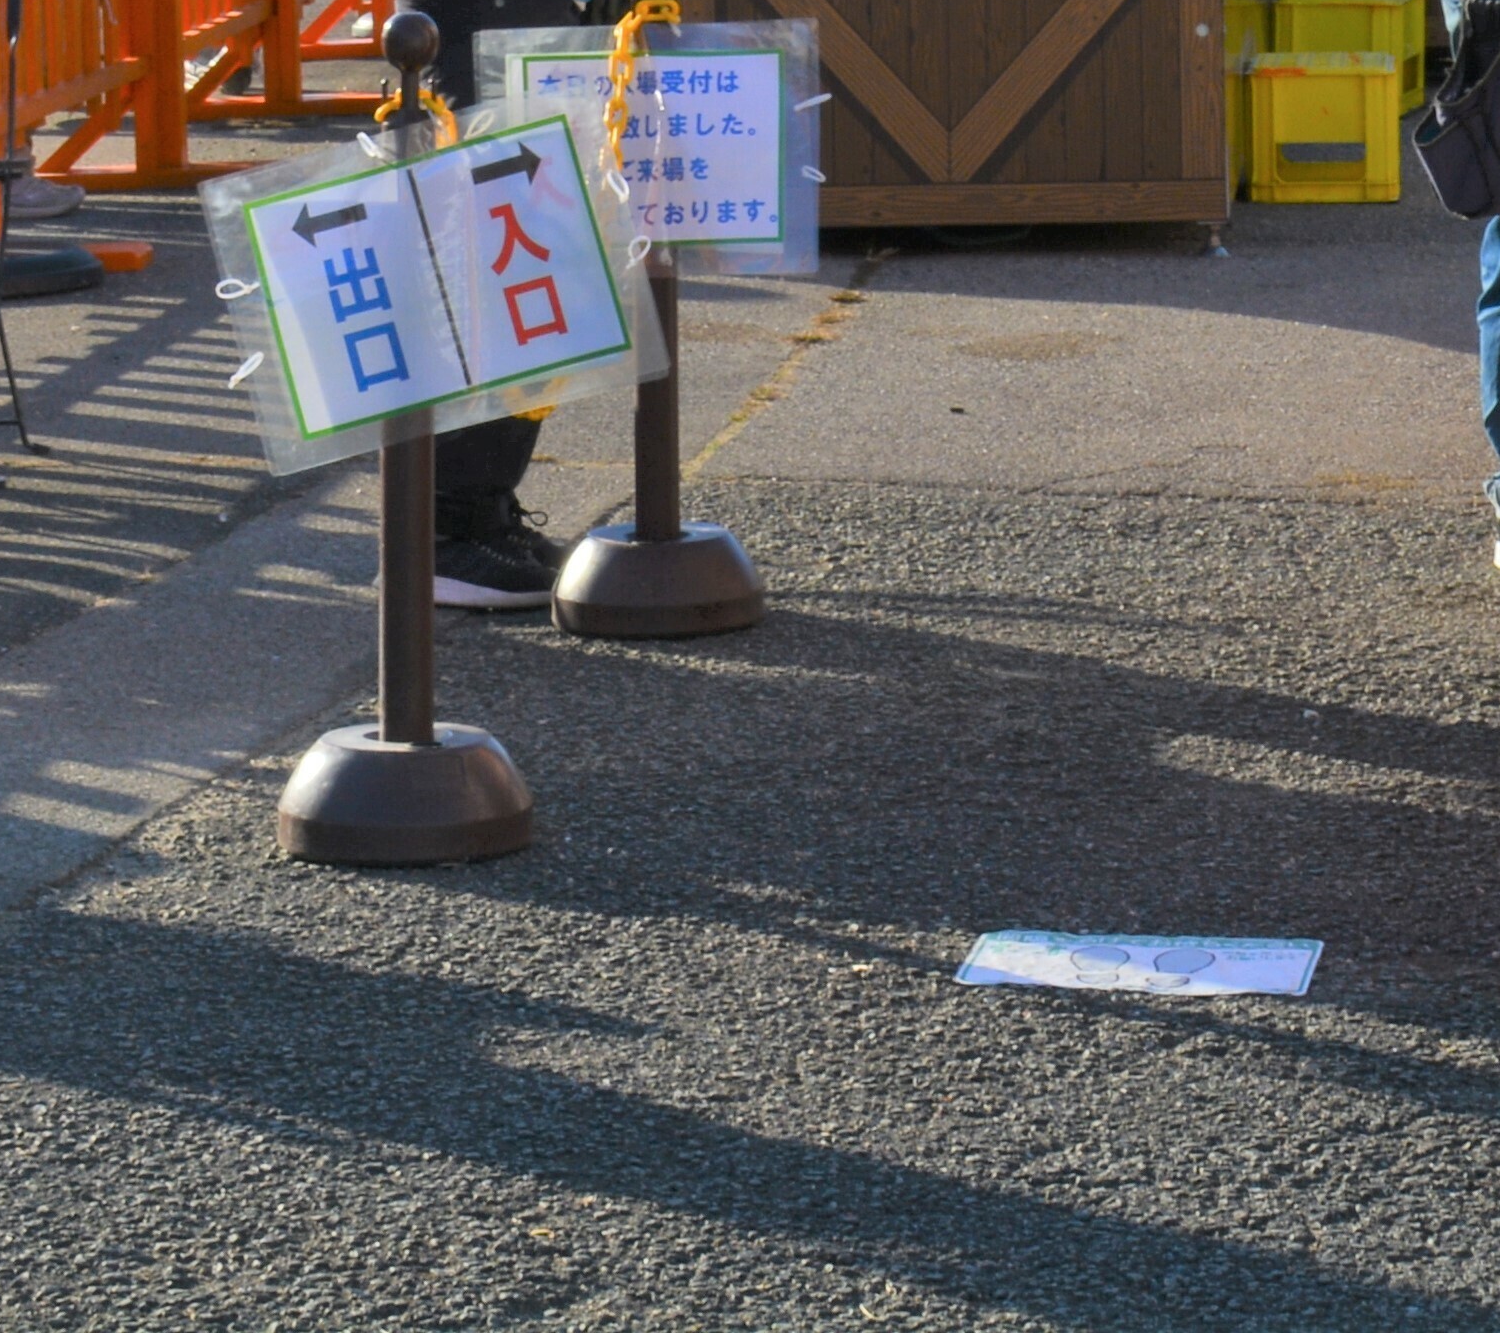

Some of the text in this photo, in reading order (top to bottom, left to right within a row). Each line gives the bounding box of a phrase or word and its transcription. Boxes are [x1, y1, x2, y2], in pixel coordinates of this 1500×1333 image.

[537, 70, 740, 97] 本日の場受付は
[324, 245, 410, 393] 出口
[489, 202, 569, 347] 入口
